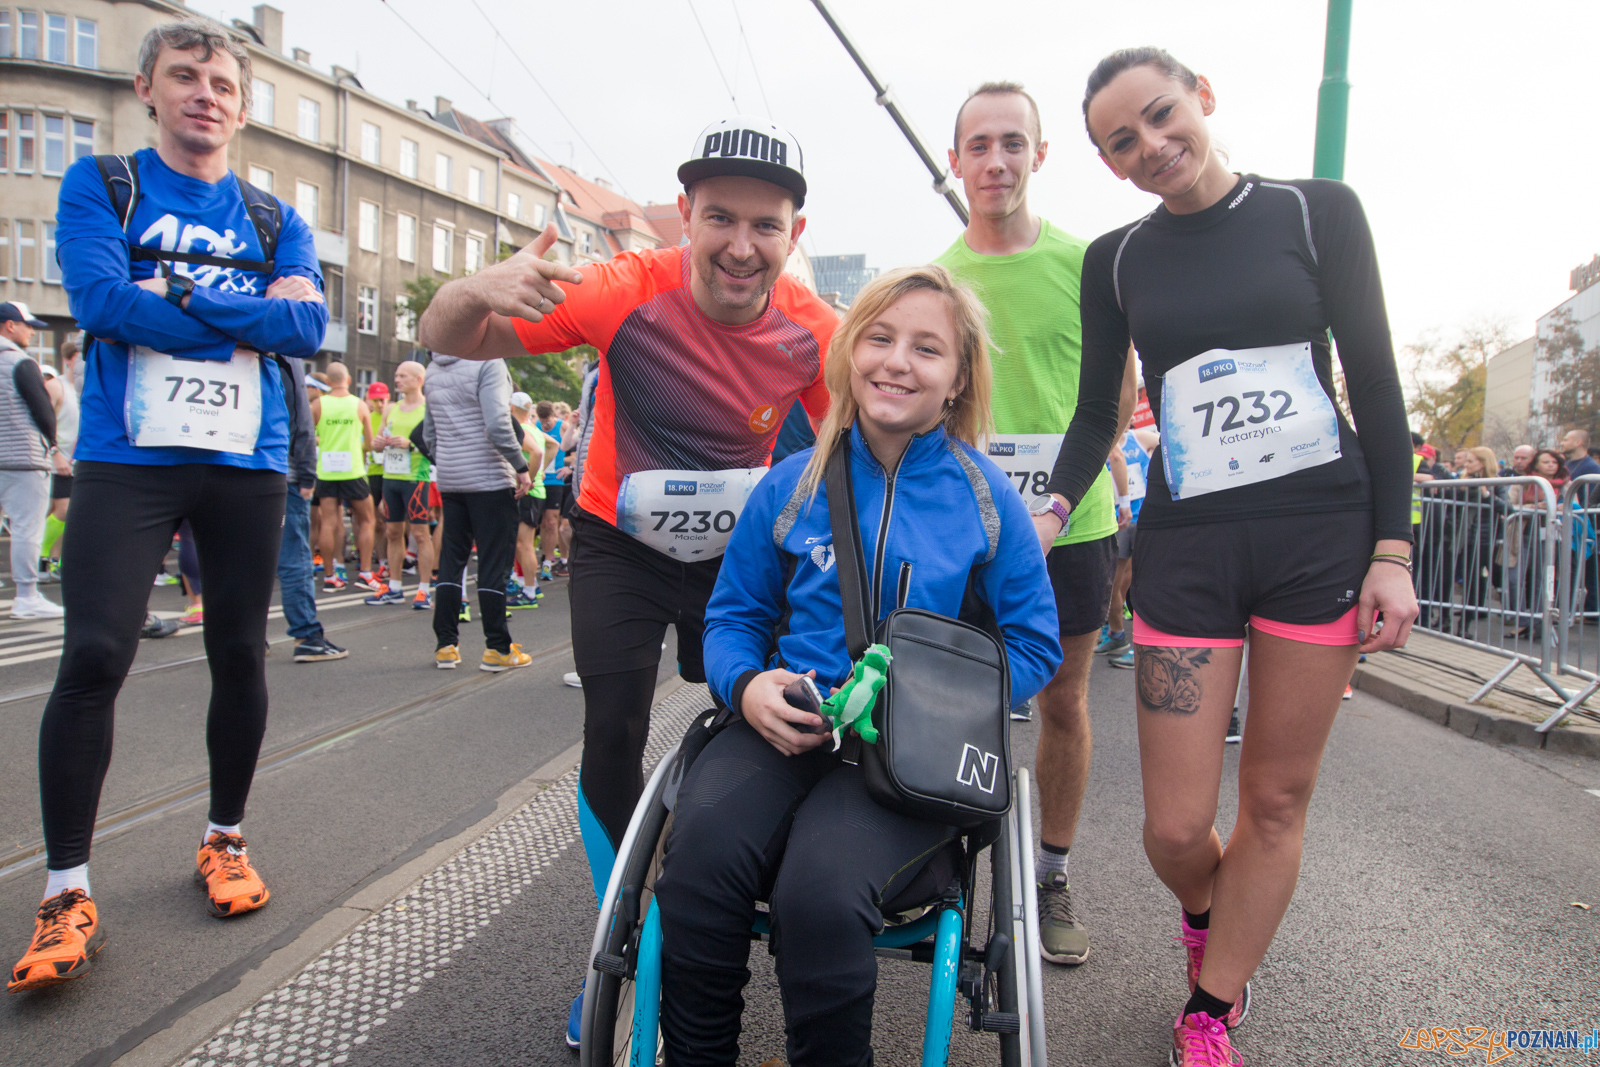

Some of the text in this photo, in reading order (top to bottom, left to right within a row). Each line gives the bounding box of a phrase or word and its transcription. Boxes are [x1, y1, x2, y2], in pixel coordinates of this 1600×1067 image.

[702, 129, 787, 166] PUMA
[1201, 363, 1233, 378] 18. PKO
[164, 375, 240, 410] 7231
[189, 405, 219, 417] Paweł
[1192, 389, 1299, 438] 7232
[1219, 424, 1282, 446] Katarzyna
[667, 484, 678, 492] 18.
[678, 484, 695, 493] PKO
[650, 509, 736, 533] 7230
[674, 533, 709, 541] Maciek
[956, 743, 999, 795] N
